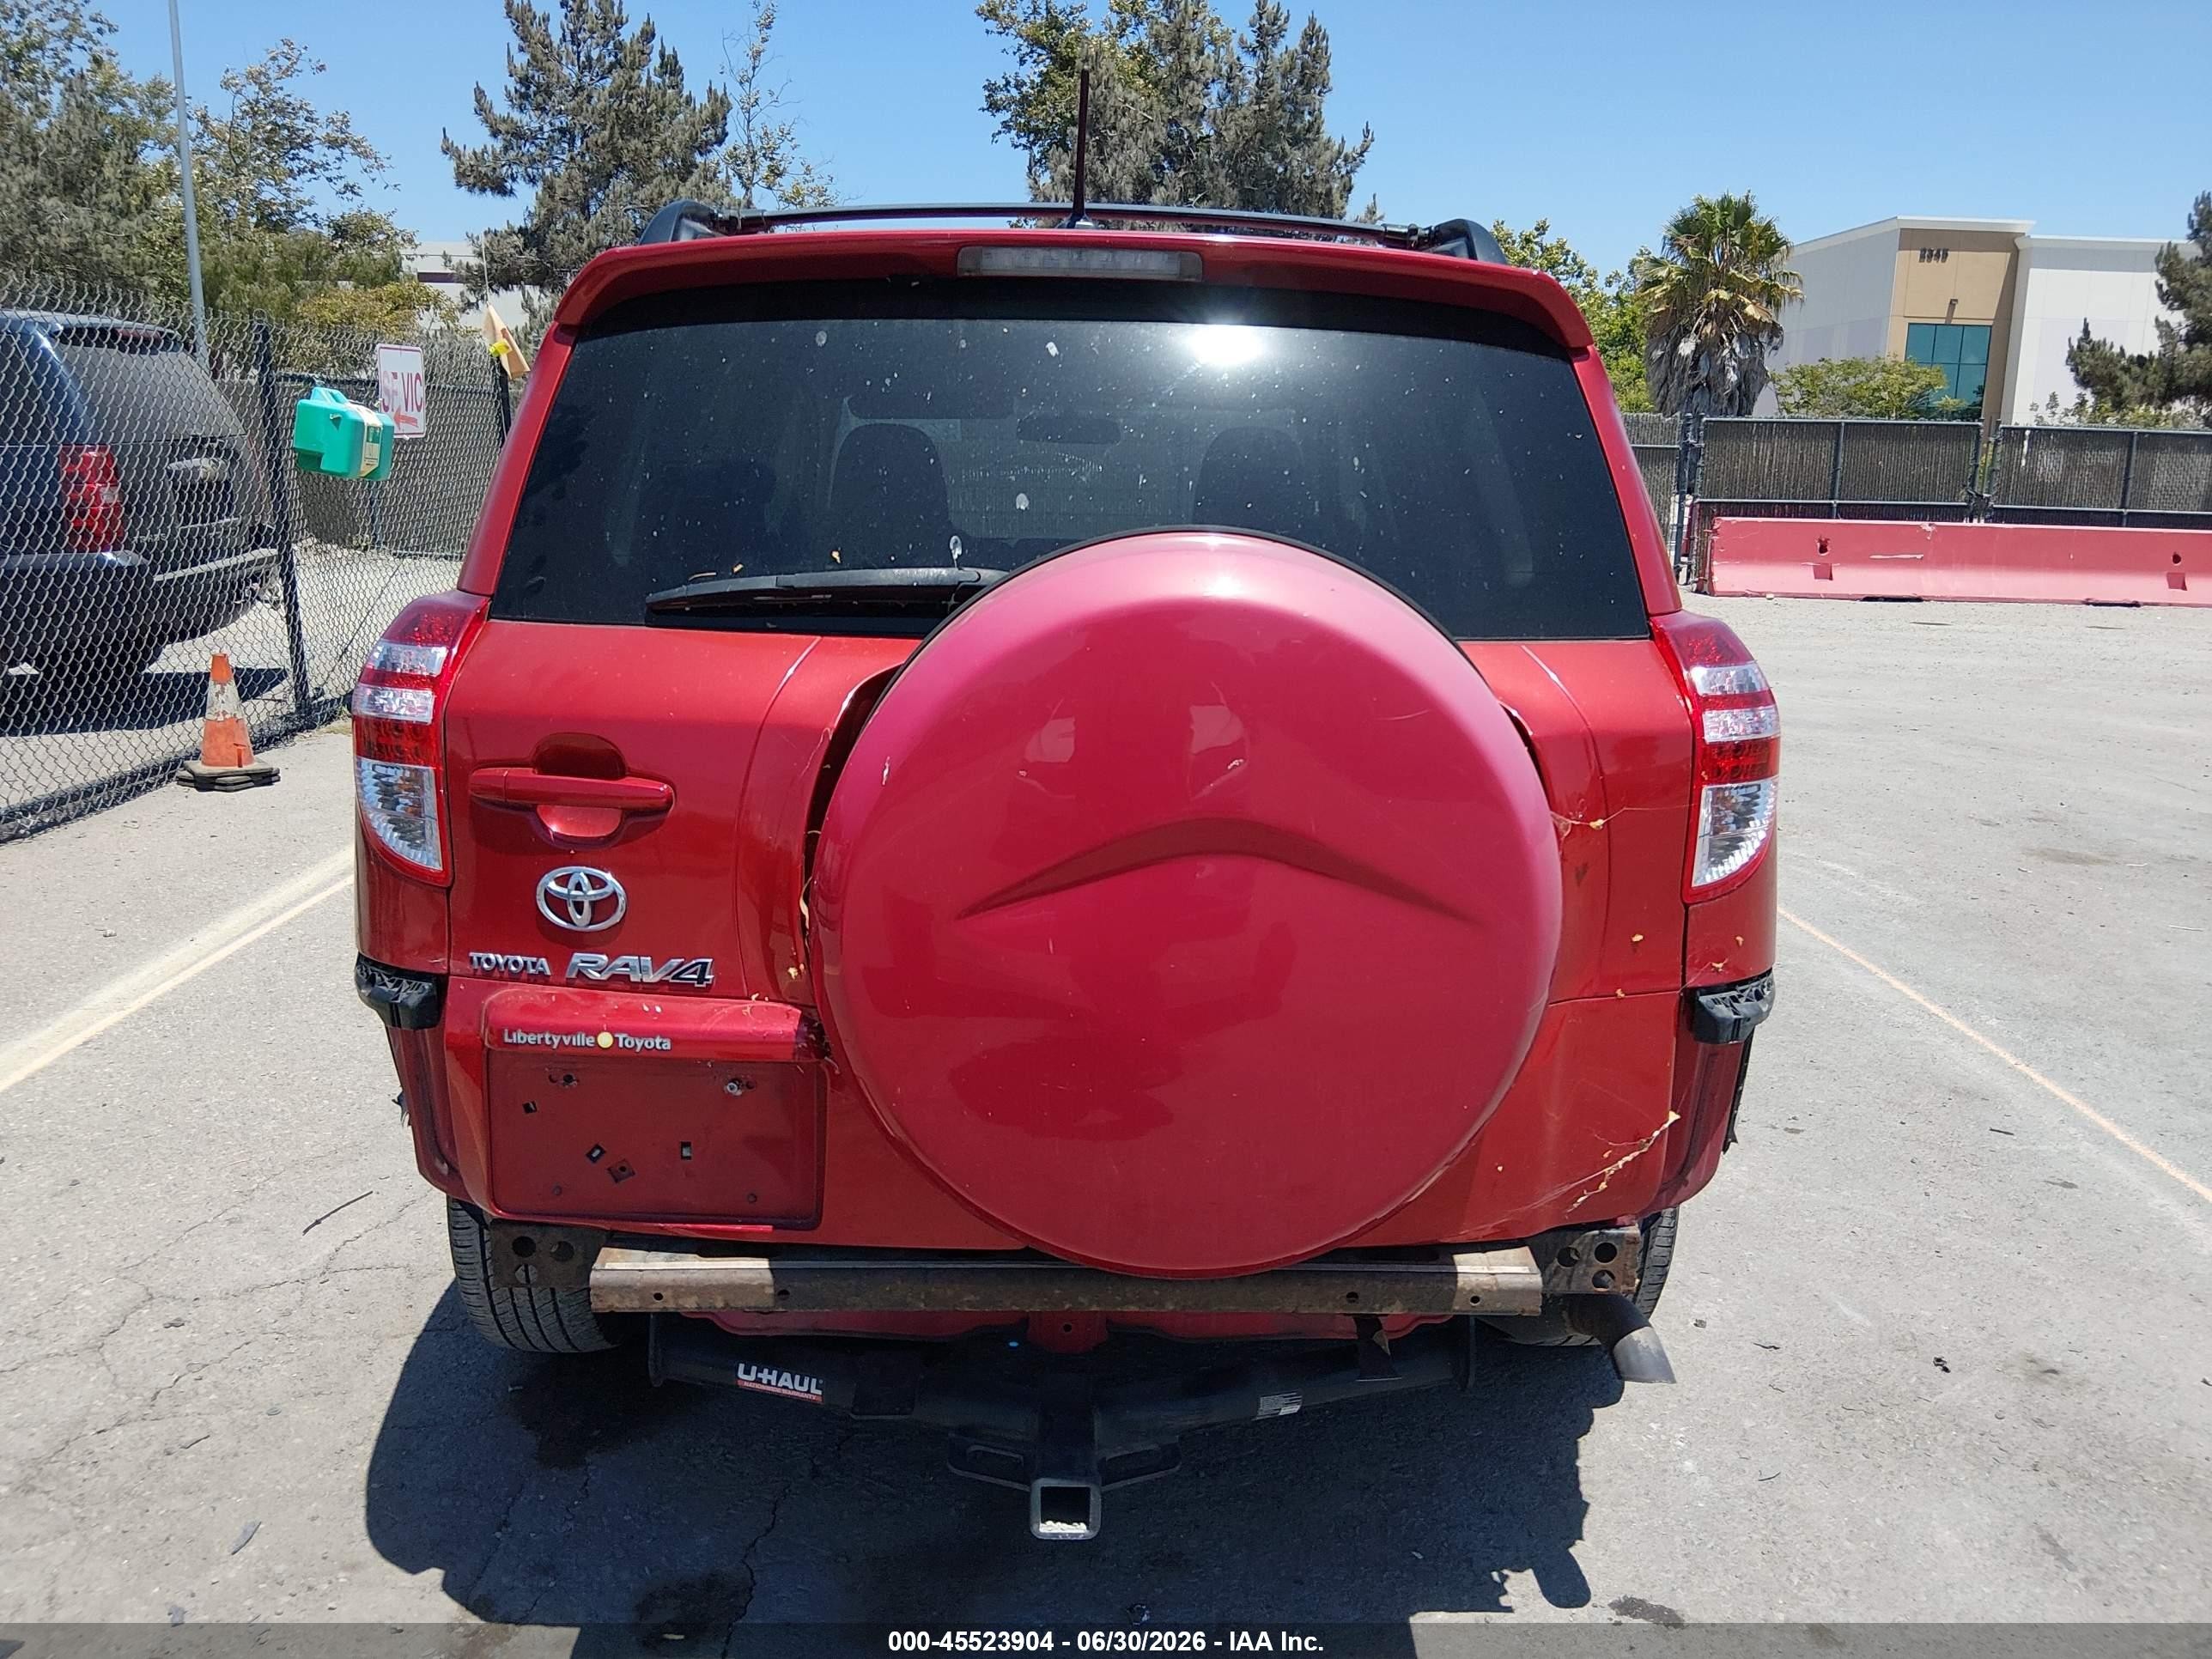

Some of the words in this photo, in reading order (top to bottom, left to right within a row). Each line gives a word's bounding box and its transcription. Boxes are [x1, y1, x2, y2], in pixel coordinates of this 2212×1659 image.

[469, 952, 551, 976] TOYOTA
[565, 952, 714, 988] RAV4
[503, 1029, 596, 1049] Libertyville
[614, 1032, 672, 1052] Toyota
